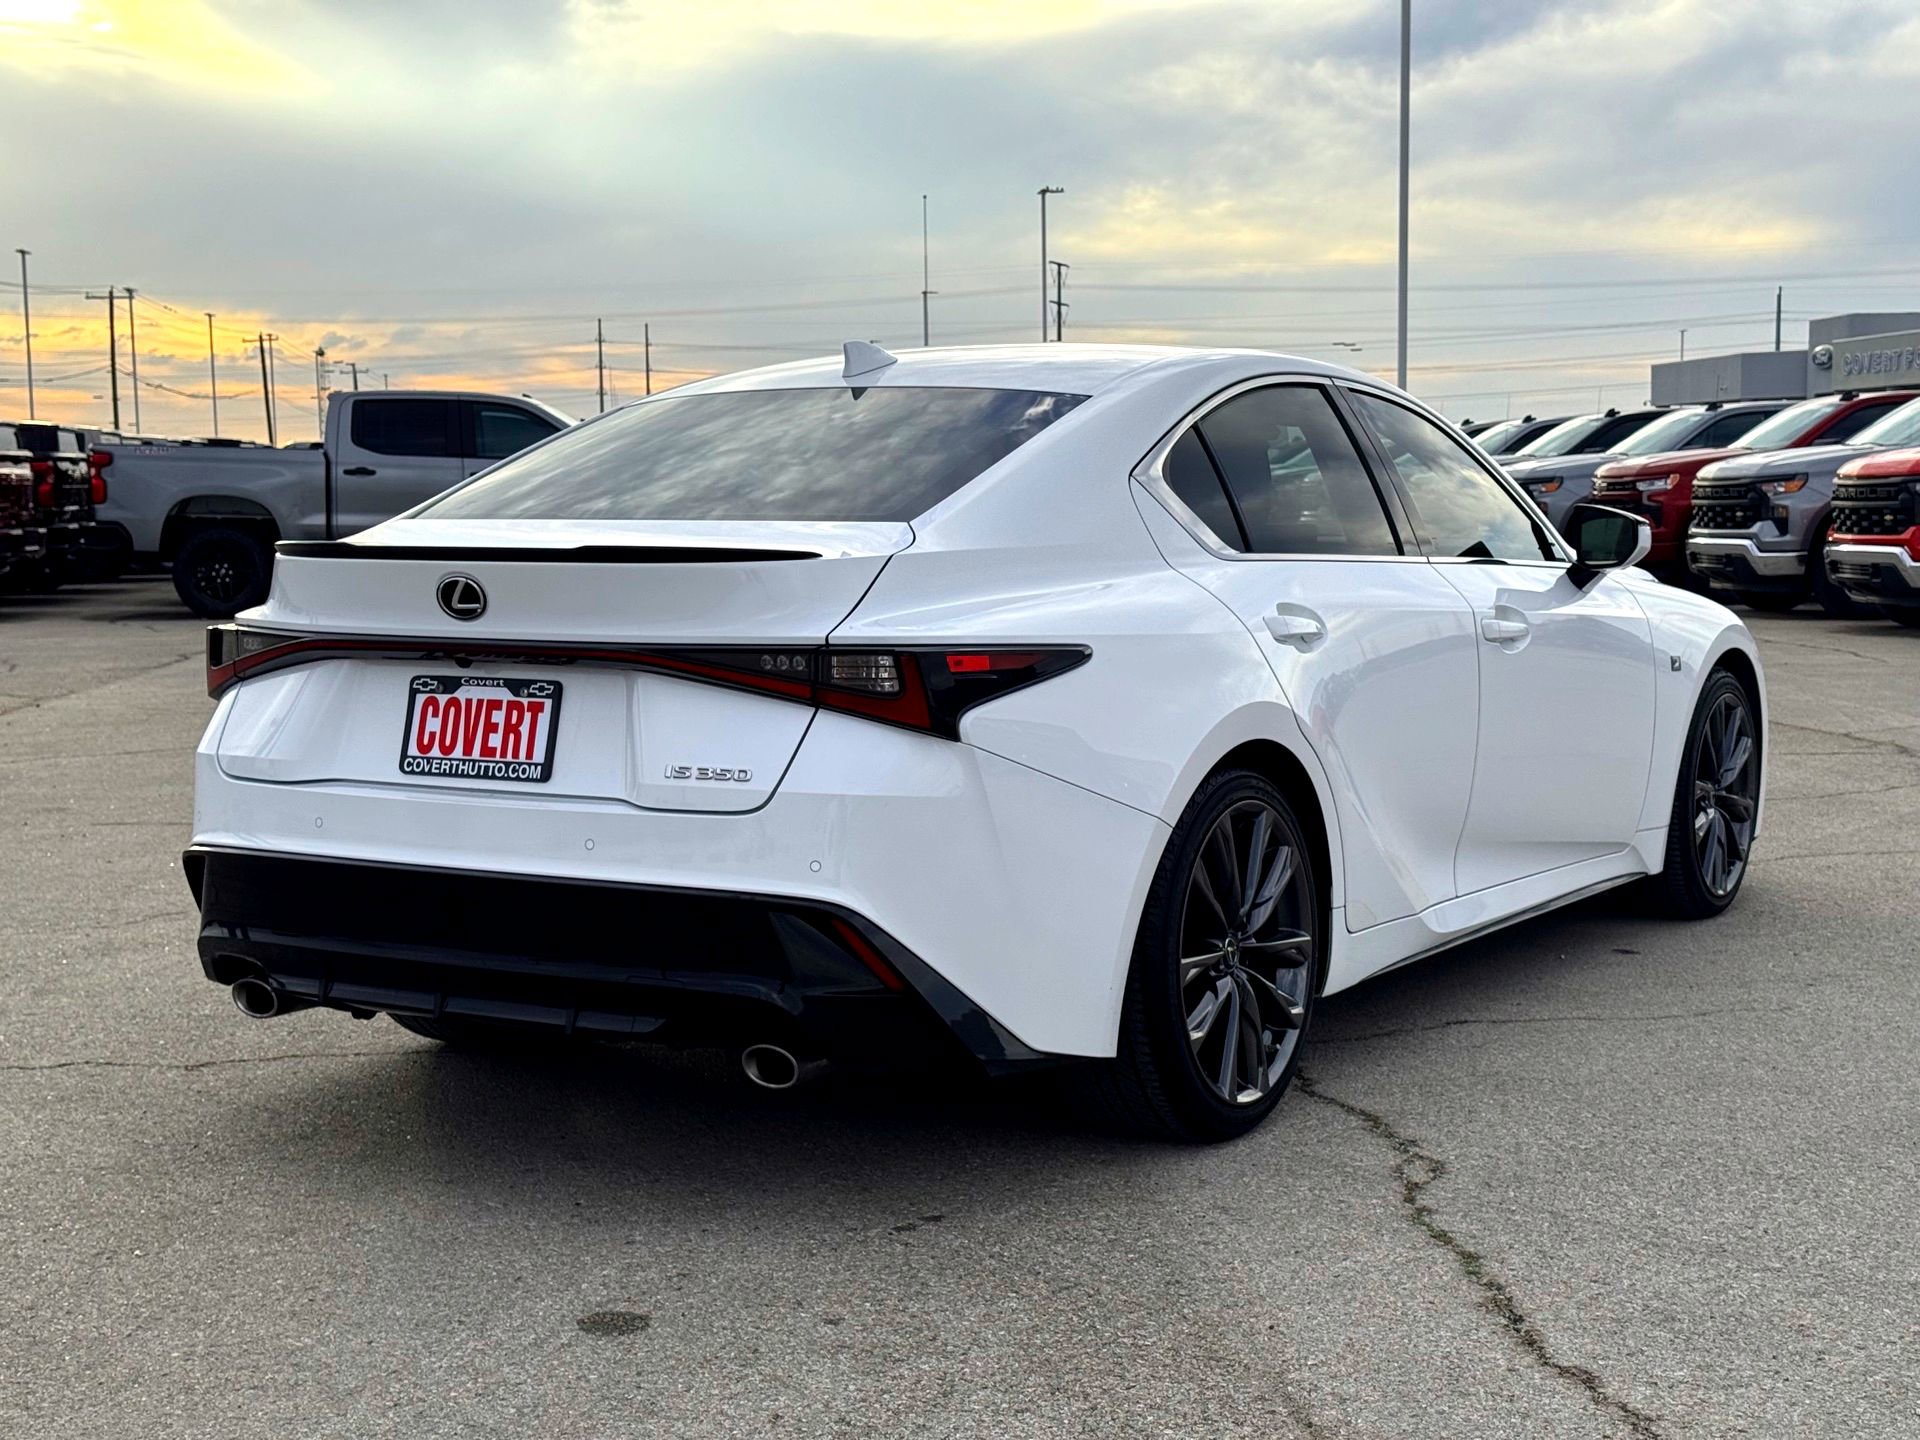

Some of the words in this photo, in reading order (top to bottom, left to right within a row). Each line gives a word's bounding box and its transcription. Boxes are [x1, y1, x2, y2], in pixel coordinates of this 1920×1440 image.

[1842, 348, 1901, 376] COVERT
[461, 677, 505, 687] Covert
[416, 695, 545, 761] COVERT
[403, 757, 542, 779] COVERTHUTTO.COM
[664, 764, 692, 779] IS
[695, 766, 753, 783] 350
